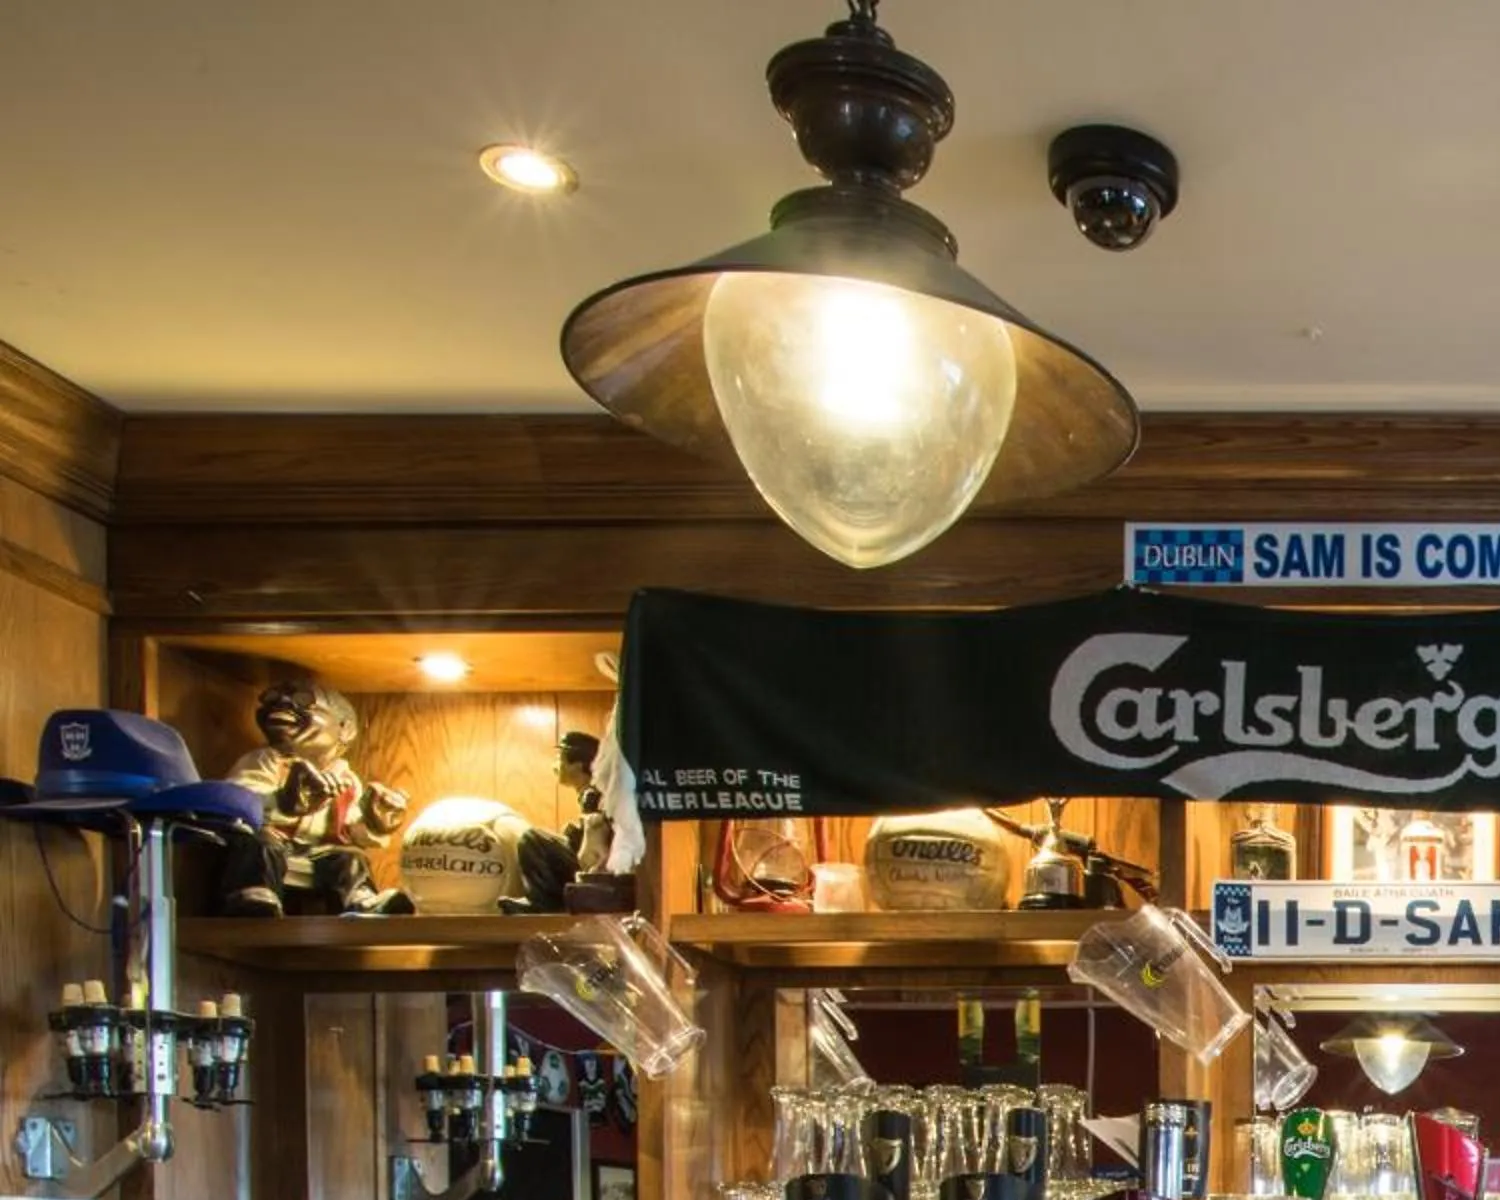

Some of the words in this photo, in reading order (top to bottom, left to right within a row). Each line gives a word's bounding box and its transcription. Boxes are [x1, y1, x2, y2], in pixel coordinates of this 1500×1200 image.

[1143, 543, 1236, 568] DUBLIN
[1253, 532, 1346, 579] SAM
[1361, 533, 1402, 579] IS
[674, 768, 718, 786] BEER
[722, 768, 749, 786] OF
[757, 770, 801, 789] THE
[702, 791, 803, 811] LEAGUE
[1283, 1136, 1332, 1160] Carlsberg
